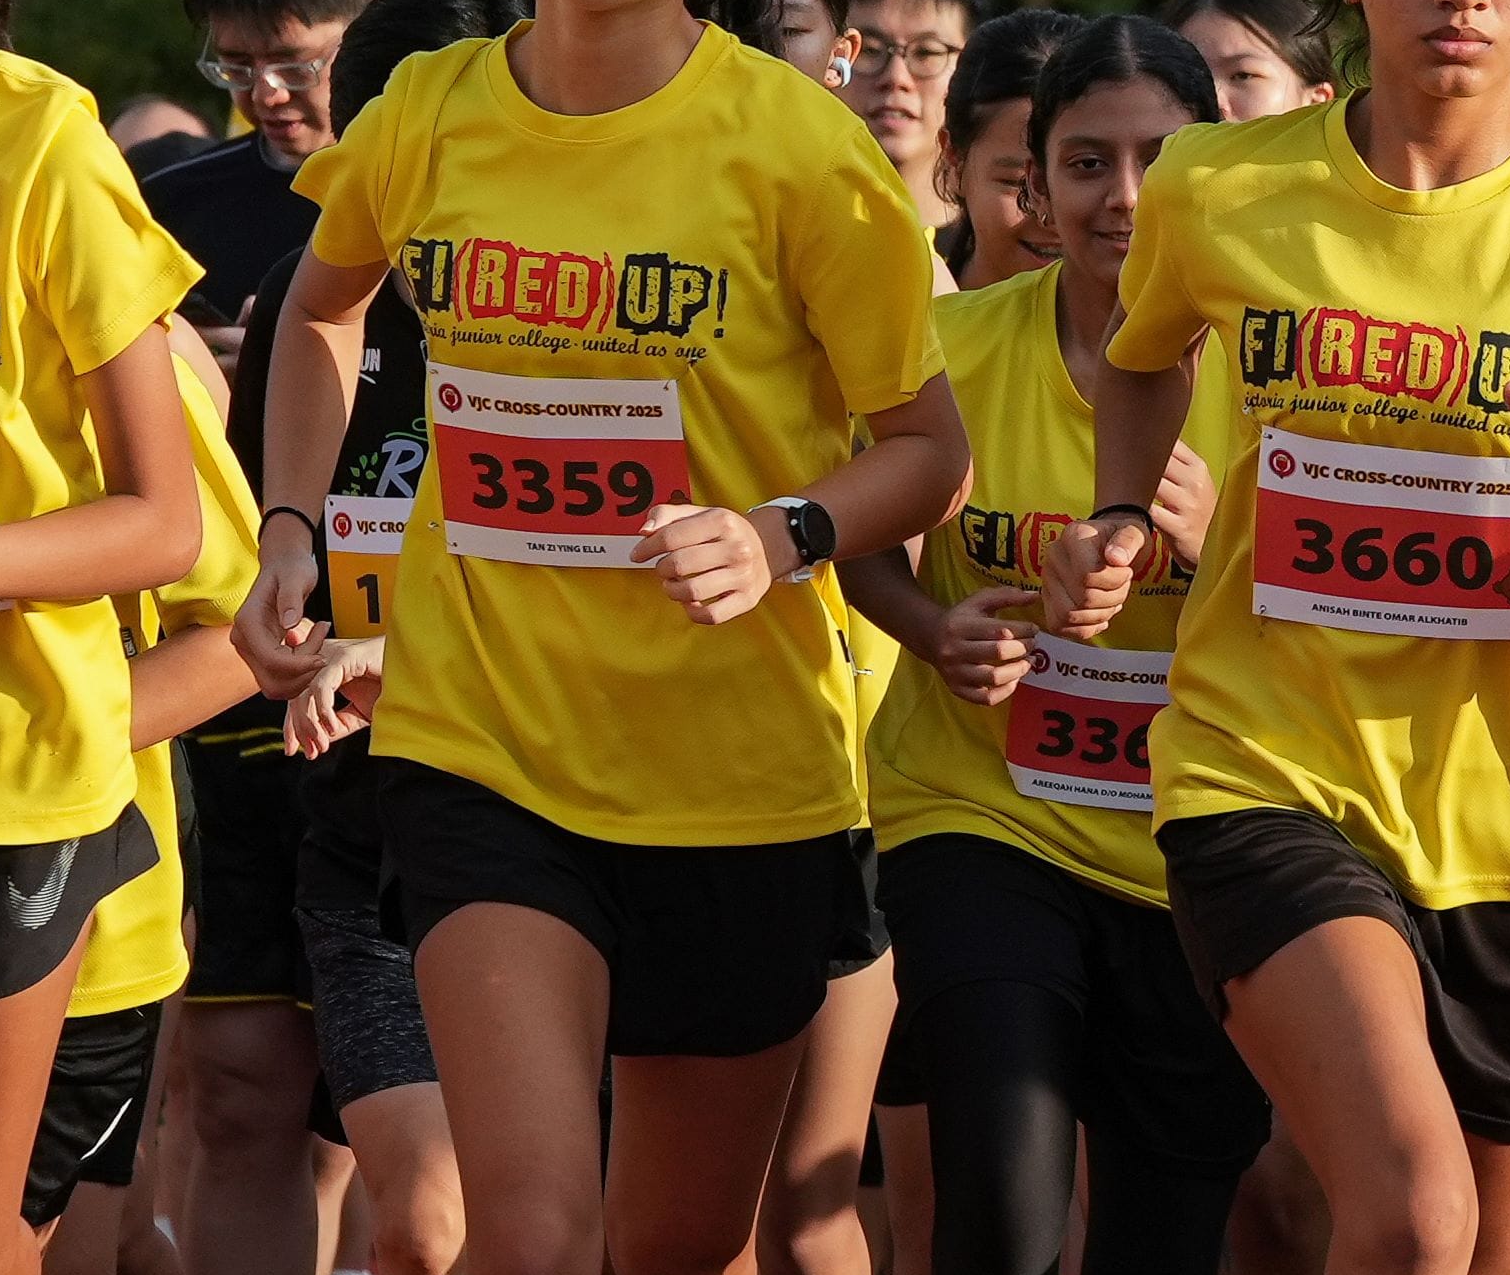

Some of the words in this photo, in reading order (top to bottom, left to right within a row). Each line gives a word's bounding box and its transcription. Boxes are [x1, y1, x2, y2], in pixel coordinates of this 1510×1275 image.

[450, 324, 503, 346] junior
[582, 337, 640, 356] united
[645, 345, 668, 358] as
[360, 348, 381, 373] UN
[467, 395, 491, 411] VJC
[495, 399, 623, 417] CROSS-COUNTRY
[626, 404, 663, 418] 2025
[1290, 394, 1347, 414] junior
[1353, 398, 1418, 425] college
[1430, 410, 1489, 433] united
[468, 452, 655, 517] 3359
[1302, 461, 1330, 480] VJC
[1333, 467, 1474, 494] CROSS-COUNTRY
[356, 520, 377, 534] VJC
[379, 521, 406, 533] CRO
[526, 541, 547, 552] TAN
[547, 542, 557, 552] ZI
[558, 543, 581, 553] YING
[583, 544, 606, 554] ELLA
[1291, 518, 1493, 591] 3660
[1311, 603, 1351, 616] ANISAH
[1353, 608, 1382, 620] BINTE
[1383, 611, 1416, 623] OMAR
[1417, 614, 1468, 627] ALKHATIB
[1055, 661, 1080, 677] VJC
[1081, 668, 1168, 685] CROSS-COUN
[1036, 709, 1151, 769] 336
[1118, 790, 1154, 800] MOHAM
